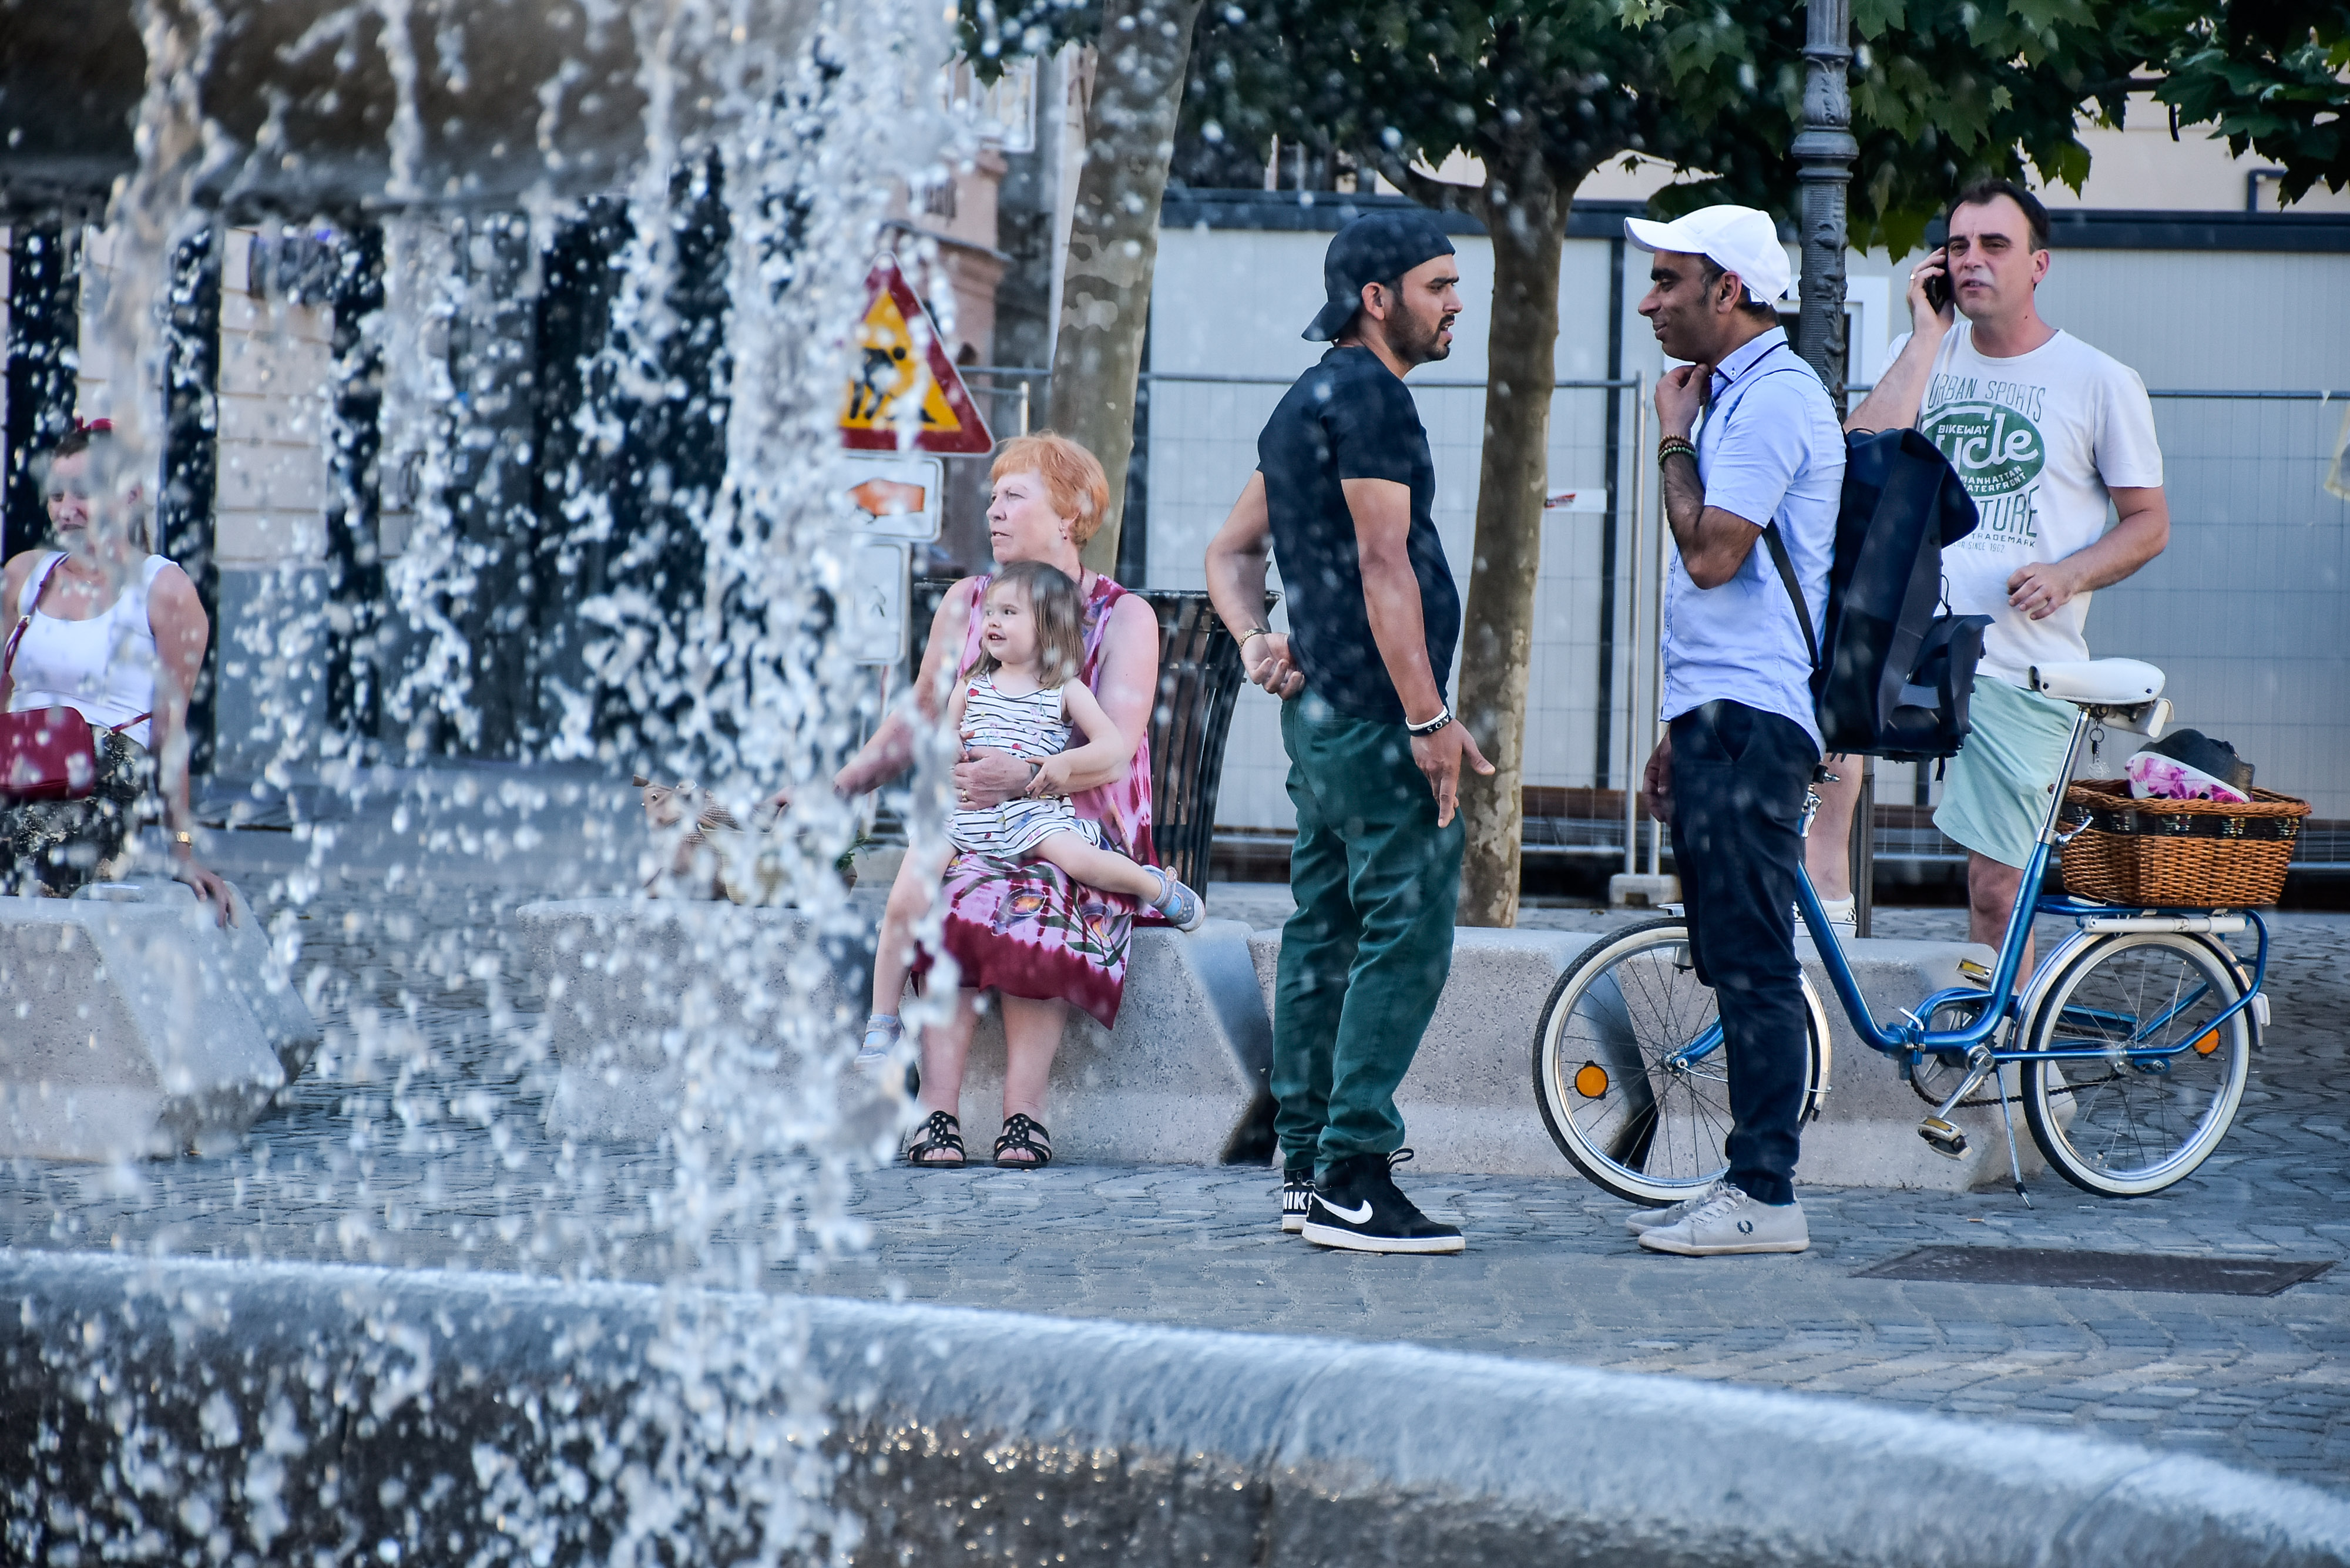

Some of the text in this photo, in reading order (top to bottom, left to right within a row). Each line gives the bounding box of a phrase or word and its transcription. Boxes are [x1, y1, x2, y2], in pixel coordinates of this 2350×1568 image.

[1928, 373, 2046, 423] URBAN SPORTS
[1938, 424, 1990, 435] BIKEWAY
[1960, 465, 2022, 485] MANHATTAN
[1964, 472, 2026, 493] ATERFRONT
[1974, 485, 2040, 538] TURE
[1968, 542, 1986, 550] SINCE
[1990, 543, 2006, 553] 1962
[1971, 532, 2036, 548] TRADEMARK
